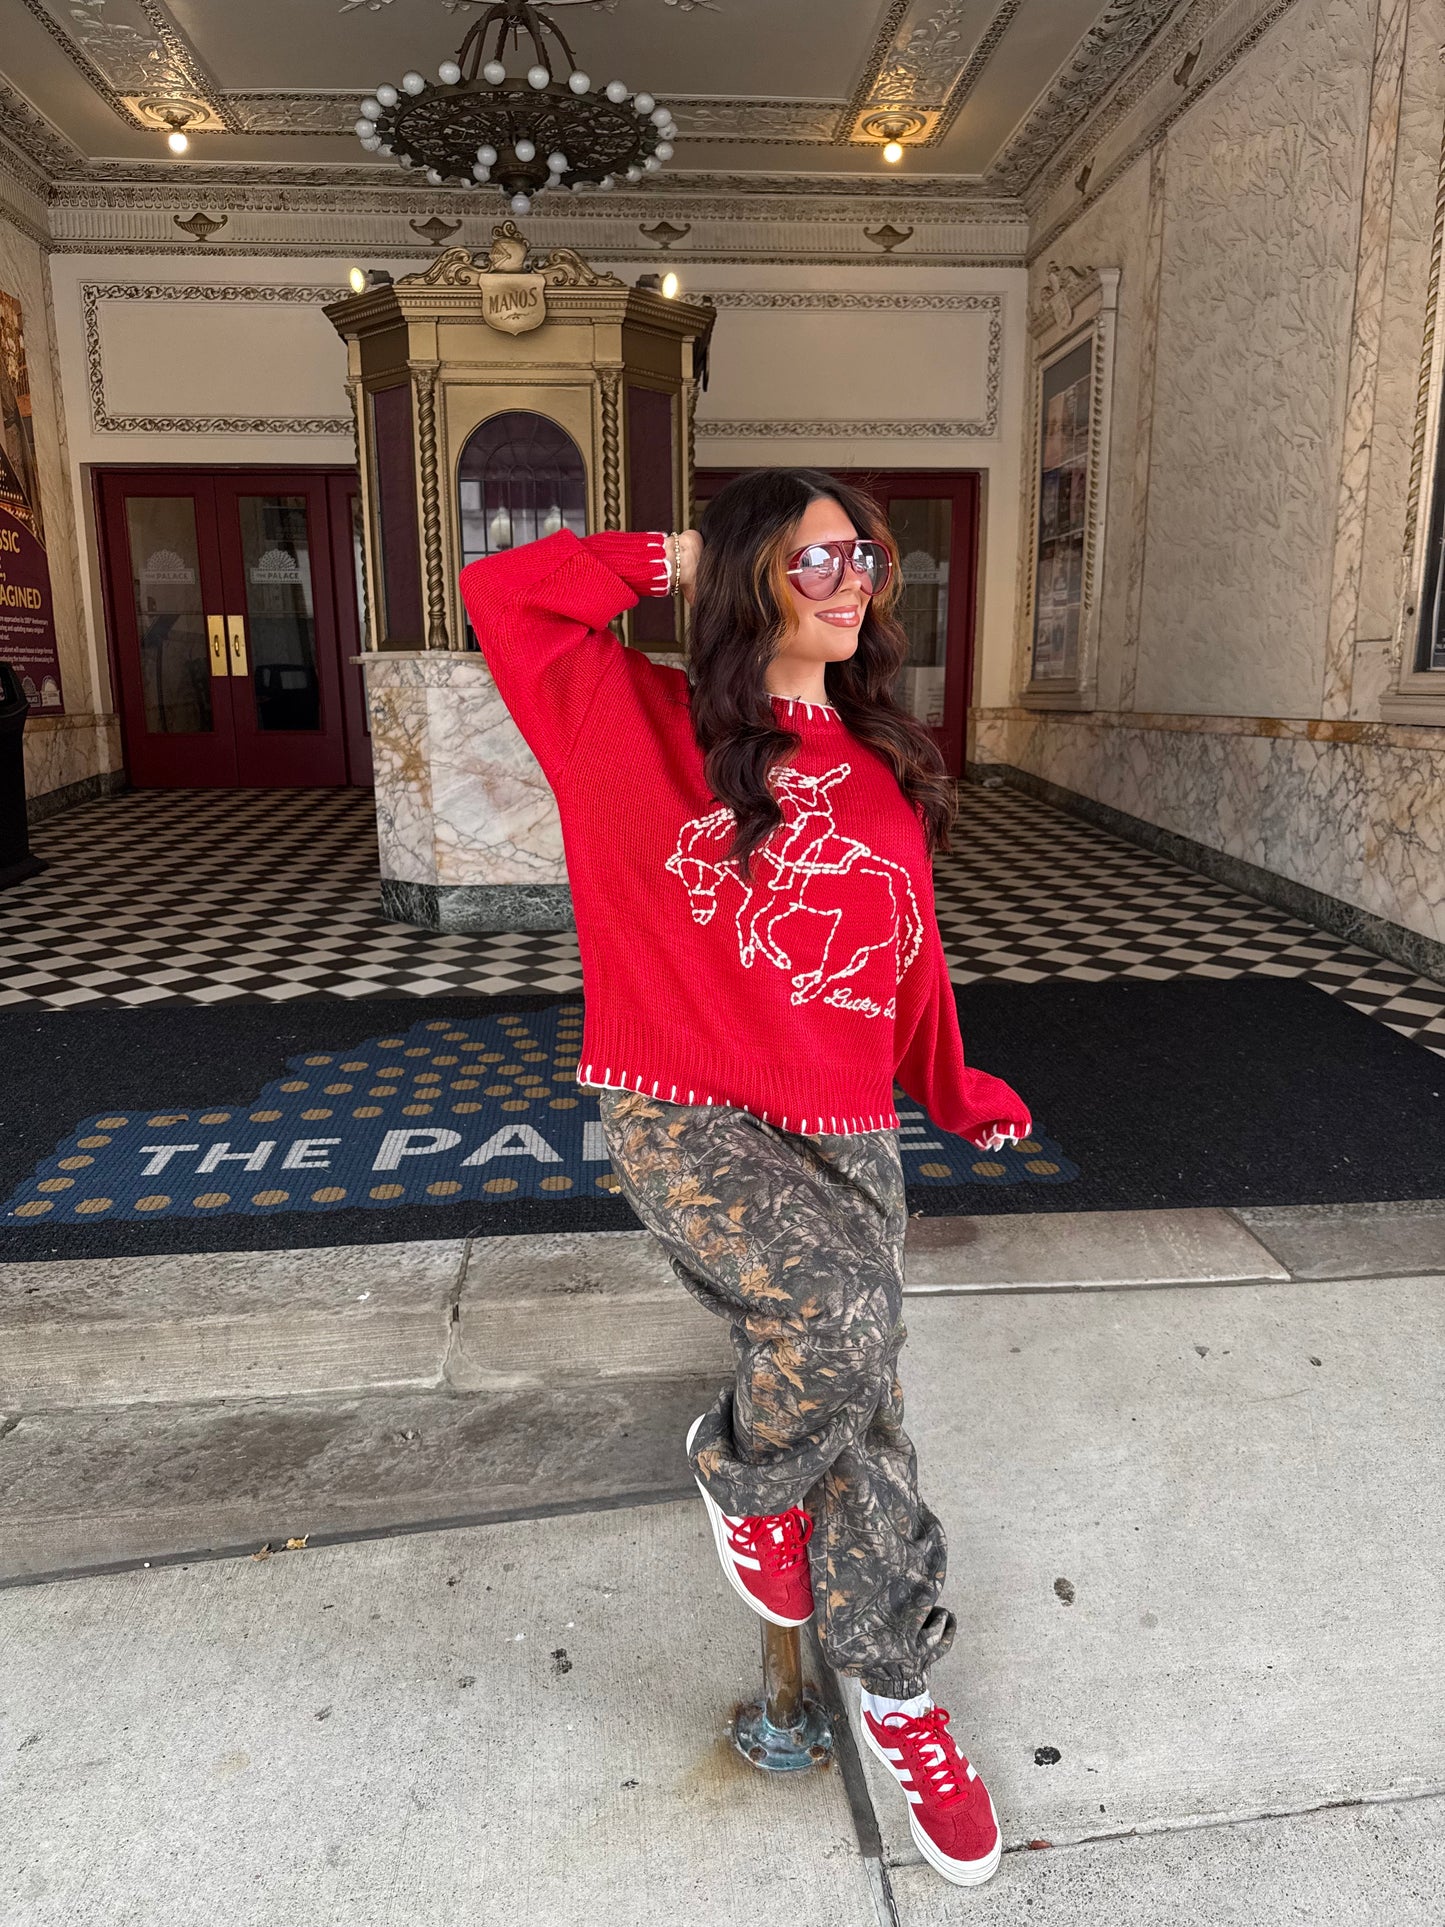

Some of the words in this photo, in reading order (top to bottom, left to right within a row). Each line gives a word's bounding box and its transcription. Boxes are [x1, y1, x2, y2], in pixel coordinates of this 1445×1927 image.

[489, 287, 537, 315] MANOS
[156, 572, 188, 580] PALACE
[267, 572, 299, 580] PALACE
[823, 988, 881, 1018] Lucky
[139, 1138, 342, 1176] THE
